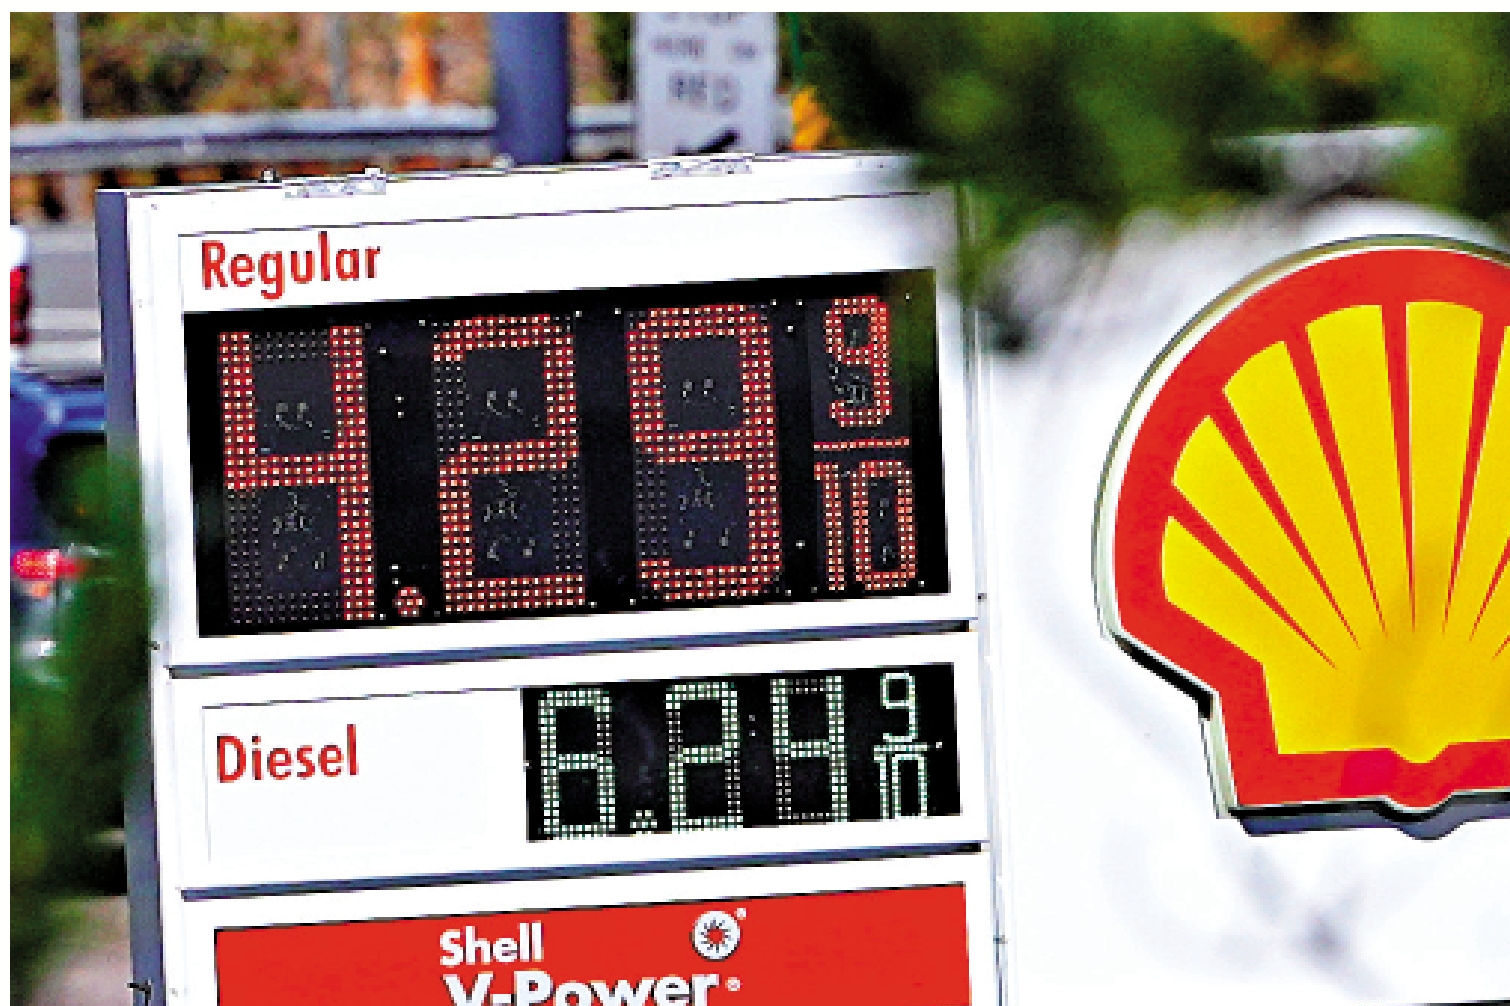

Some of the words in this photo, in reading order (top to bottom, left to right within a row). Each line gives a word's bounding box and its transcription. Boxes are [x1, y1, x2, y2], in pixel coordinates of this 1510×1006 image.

[202, 231, 382, 301] Regular
[823, 296, 891, 427] 9
[217, 303, 781, 622] 4.29
[813, 460, 917, 590] 10
[880, 673, 917, 742] 9
[217, 724, 359, 783] Diesel
[440, 920, 544, 967] Shell
